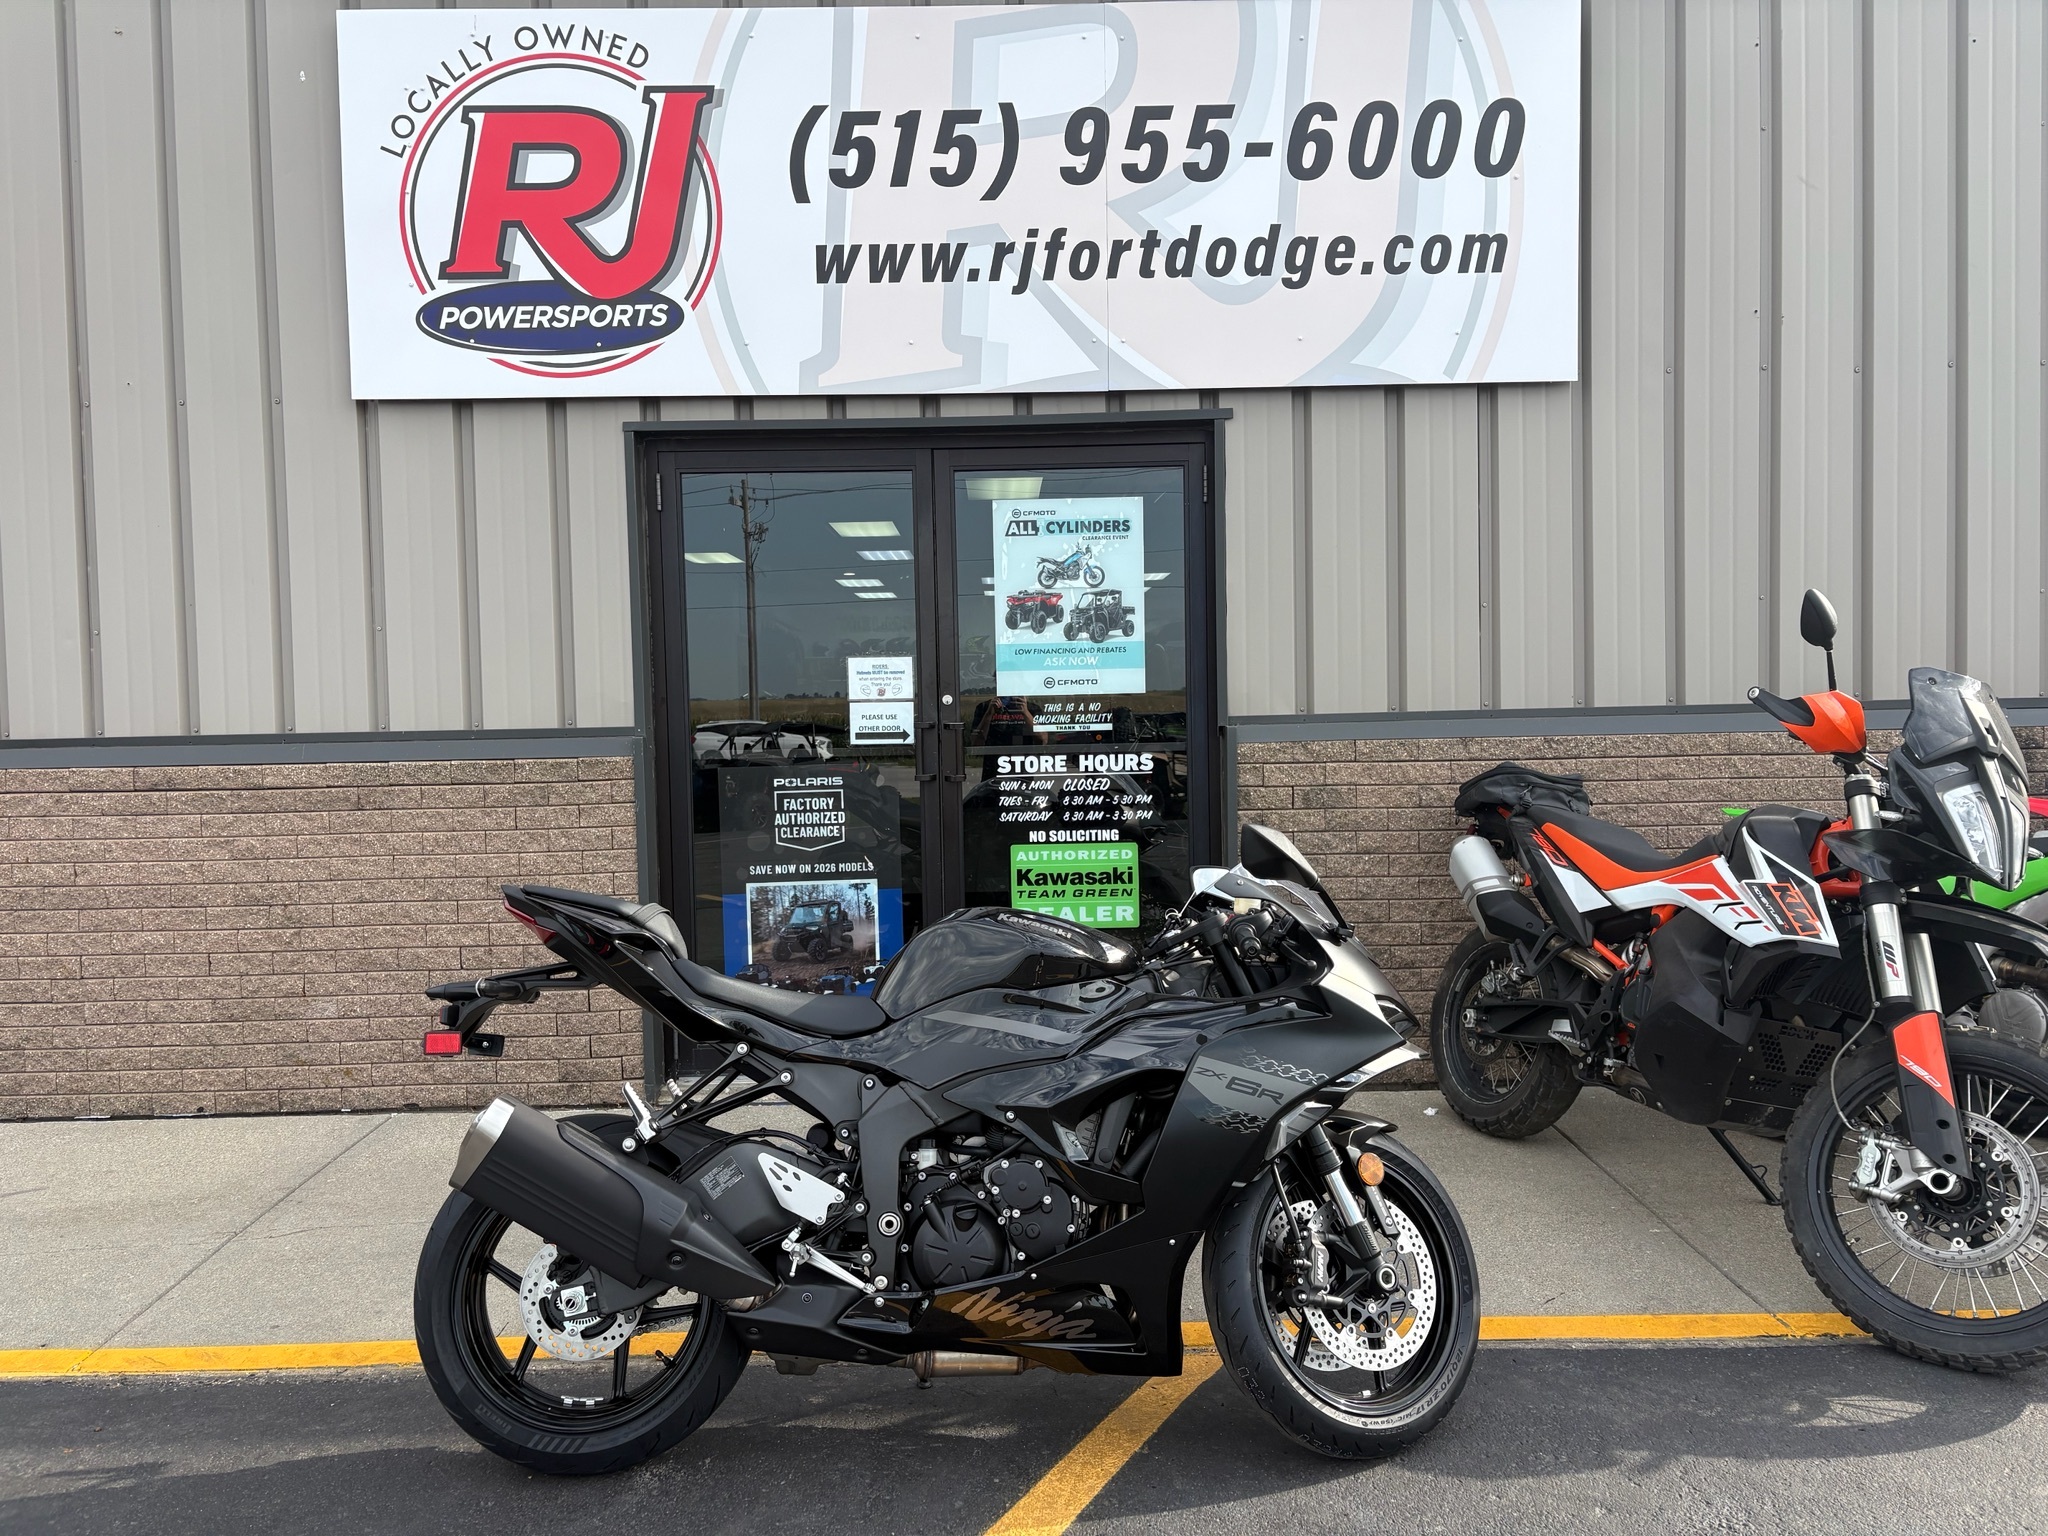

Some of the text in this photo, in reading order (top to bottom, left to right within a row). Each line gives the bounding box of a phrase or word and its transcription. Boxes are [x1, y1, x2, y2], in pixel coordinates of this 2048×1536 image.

[380, 23, 650, 159] LOCALLY OWNED
[789, 96, 1526, 204] (515) 955-6000
[438, 85, 722, 299] RJ
[814, 224, 1509, 296] www.rjfortdodge.com
[439, 303, 669, 330] POWERSPORTS
[1007, 520, 1131, 535] ALL CYLINDERS
[1044, 656, 1099, 666] ASK NOW
[1044, 702, 1101, 712] THIS IS A NO
[1033, 714, 1071, 724] SMOKING
[1075, 713, 1113, 723] FACILITY
[997, 753, 1154, 774] STORE HOURS
[773, 776, 844, 787] POLARIS
[999, 781, 1021, 791] SUN
[1029, 780, 1054, 790] MON
[1063, 778, 1110, 791] CLOSED
[783, 797, 834, 811] FACTORY
[999, 796, 1022, 806] TUES
[1031, 796, 1049, 806] FRI
[1085, 795, 1104, 805] AM
[1135, 794, 1153, 804] PM
[774, 811, 846, 826] AUTHORIZED
[999, 811, 1053, 822] SATURDAY
[1085, 811, 1104, 821] AM
[1135, 810, 1153, 820] PM
[780, 825, 840, 838] CLEARANCE
[1029, 829, 1119, 842] NO SOLICITING
[1016, 850, 1133, 861] AUTHORIZED
[749, 862, 874, 875] SAVE NOW ON 2026 MODELS
[1016, 866, 1133, 887] Kawasaki
[1017, 888, 1134, 899] TEAM GREEN
[1752, 885, 1784, 925] ADVENTURE
[1767, 883, 1822, 936] KTM
[1019, 906, 1134, 921] ALER
[997, 913, 1072, 939] Kawasaki
[950, 1286, 1097, 1340] Ninja
